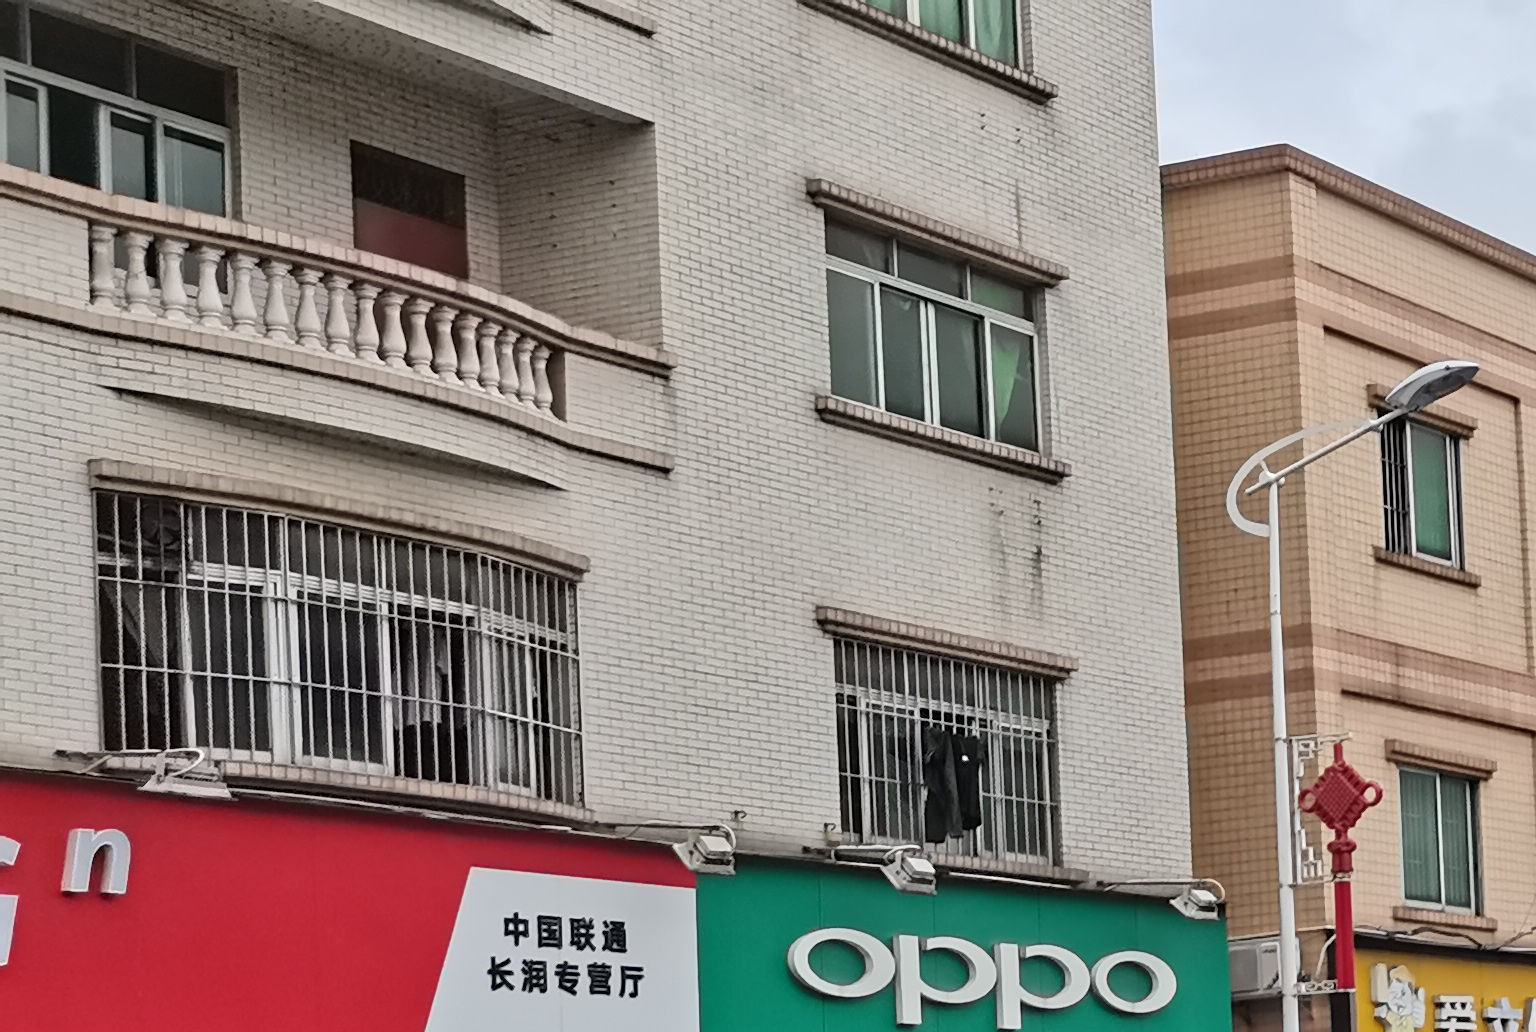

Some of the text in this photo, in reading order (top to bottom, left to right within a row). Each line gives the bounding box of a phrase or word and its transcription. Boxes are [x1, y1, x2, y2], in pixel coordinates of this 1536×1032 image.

[503, 912, 628, 954] 中国联通
[487, 956, 645, 998] 长润专营厅
